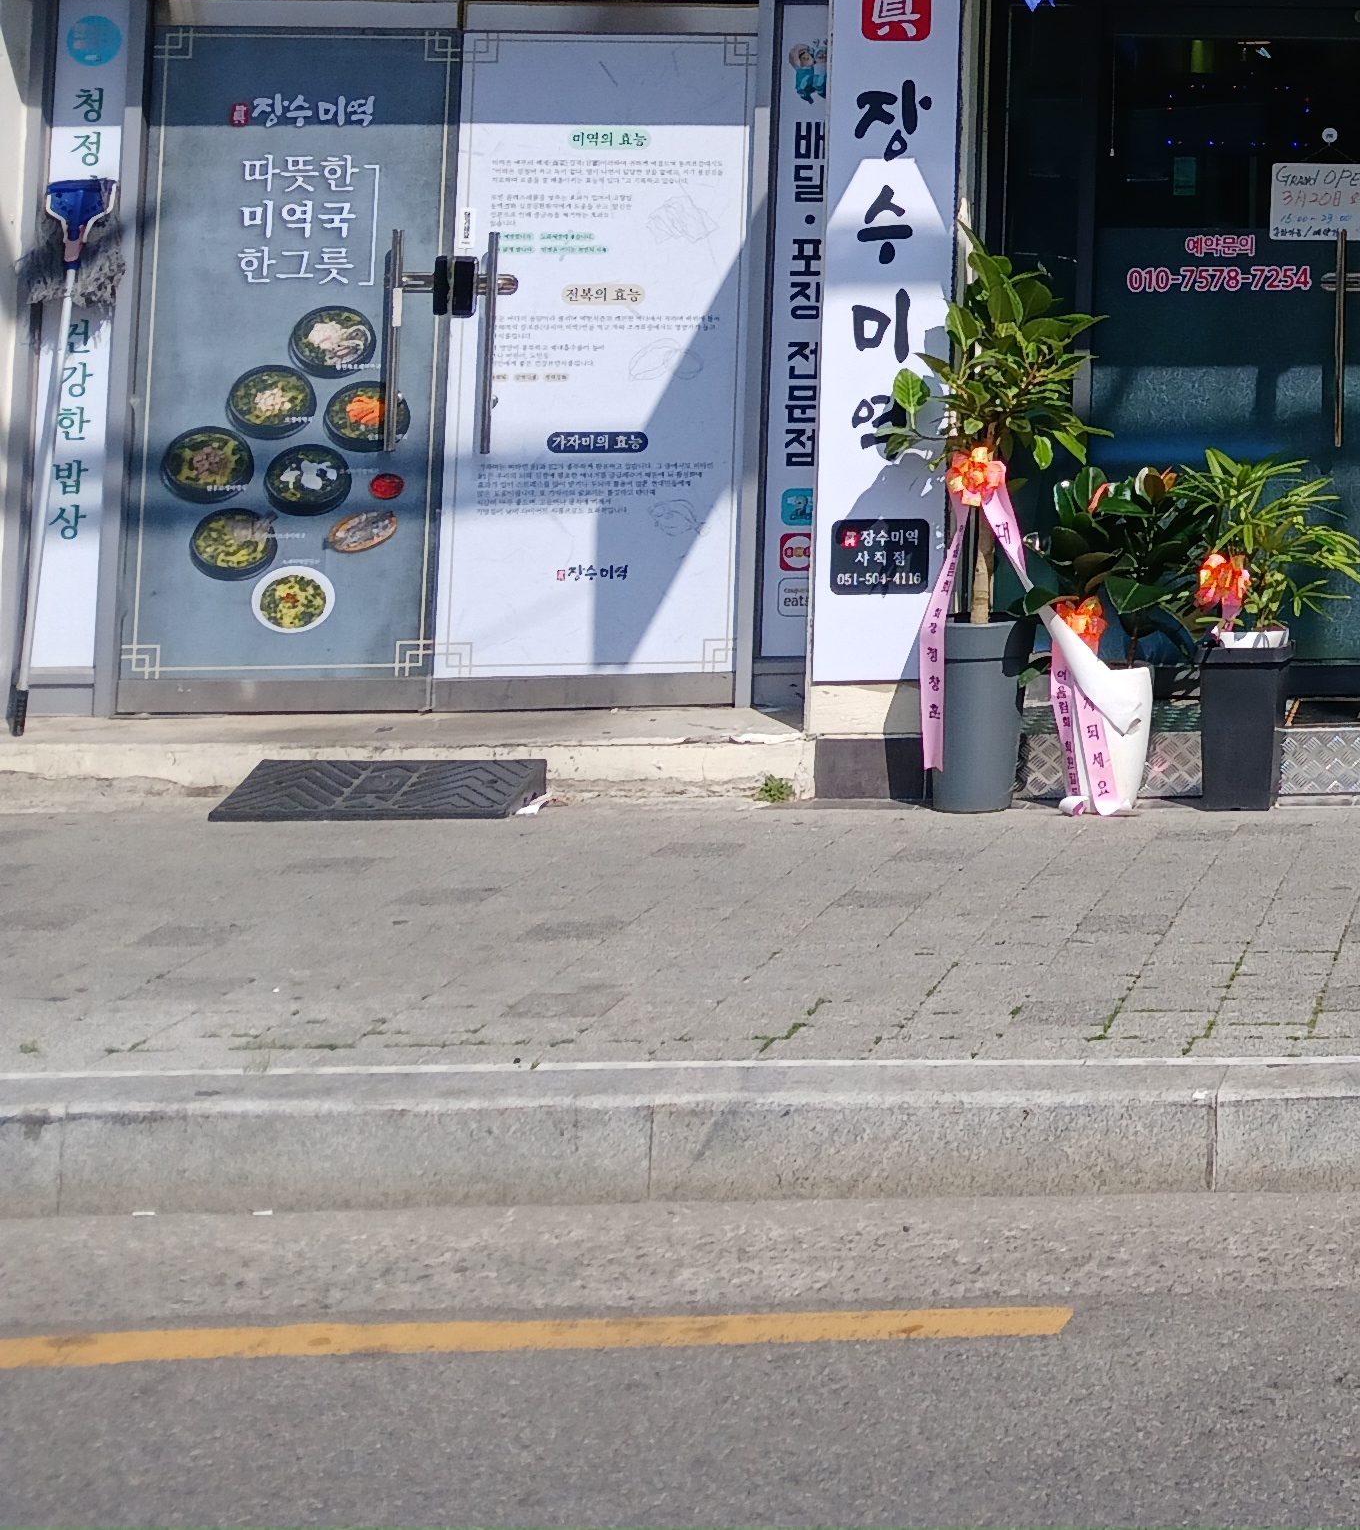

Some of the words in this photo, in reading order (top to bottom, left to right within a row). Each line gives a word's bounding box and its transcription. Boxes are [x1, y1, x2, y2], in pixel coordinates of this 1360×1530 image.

[251, 94, 376, 127] 장수미역
[571, 130, 614, 147] 미역의
[619, 130, 648, 147] 효능
[242, 154, 360, 193] 따뜻한
[240, 202, 357, 239] 미역국
[1184, 234, 1256, 258] 예약문의
[238, 245, 355, 284] 한그릇
[1126, 266, 1312, 292] 010-7578-7254
[565, 287, 608, 302] 전복의
[611, 287, 642, 303] 효능
[784, 341, 818, 469] 전문점
[551, 434, 610, 450] 가자미의
[614, 435, 644, 450] 효능
[48, 460, 90, 541] 밥상
[860, 529, 919, 547] 장수미역
[854, 550, 906, 567] 사직점
[836, 572, 922, 586] 051-504-4116
